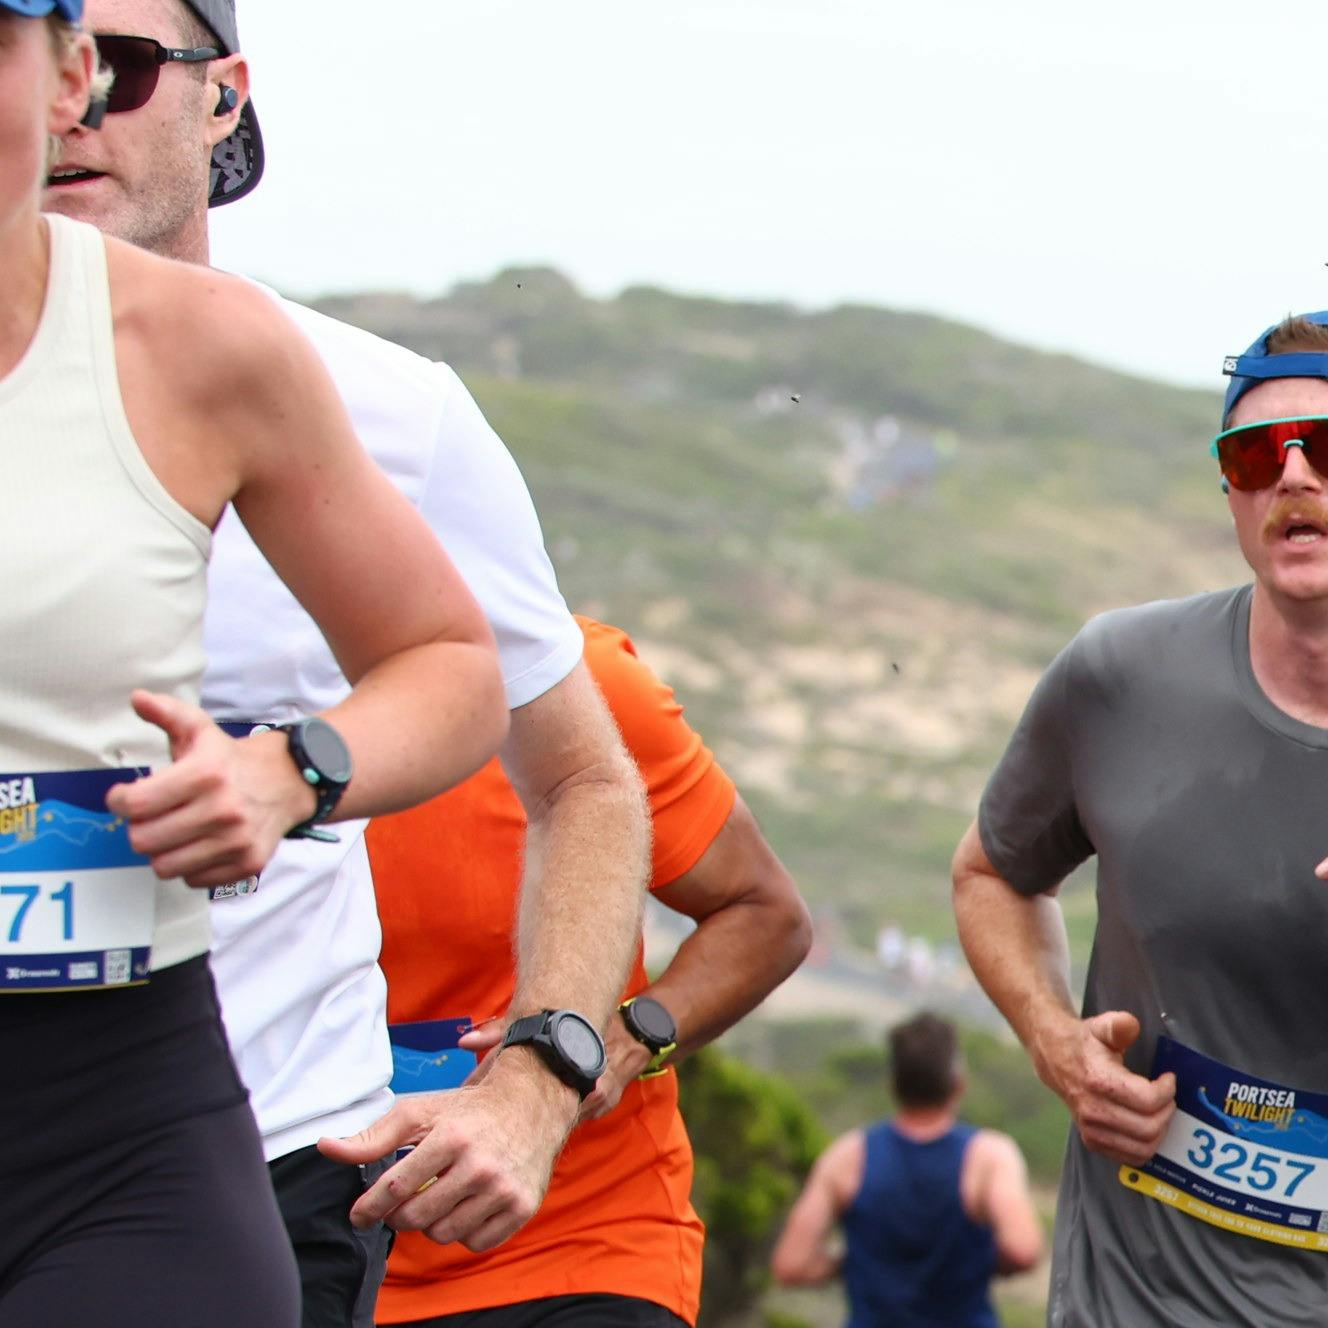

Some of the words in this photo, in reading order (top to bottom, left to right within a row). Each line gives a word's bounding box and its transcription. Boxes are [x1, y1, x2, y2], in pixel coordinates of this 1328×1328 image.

[0, 881, 74, 942] 71
[1223, 1096, 1296, 1124] TWILIGHT
[1227, 1082, 1296, 1107] PORTSEA
[1187, 1129, 1316, 1198] 3257
